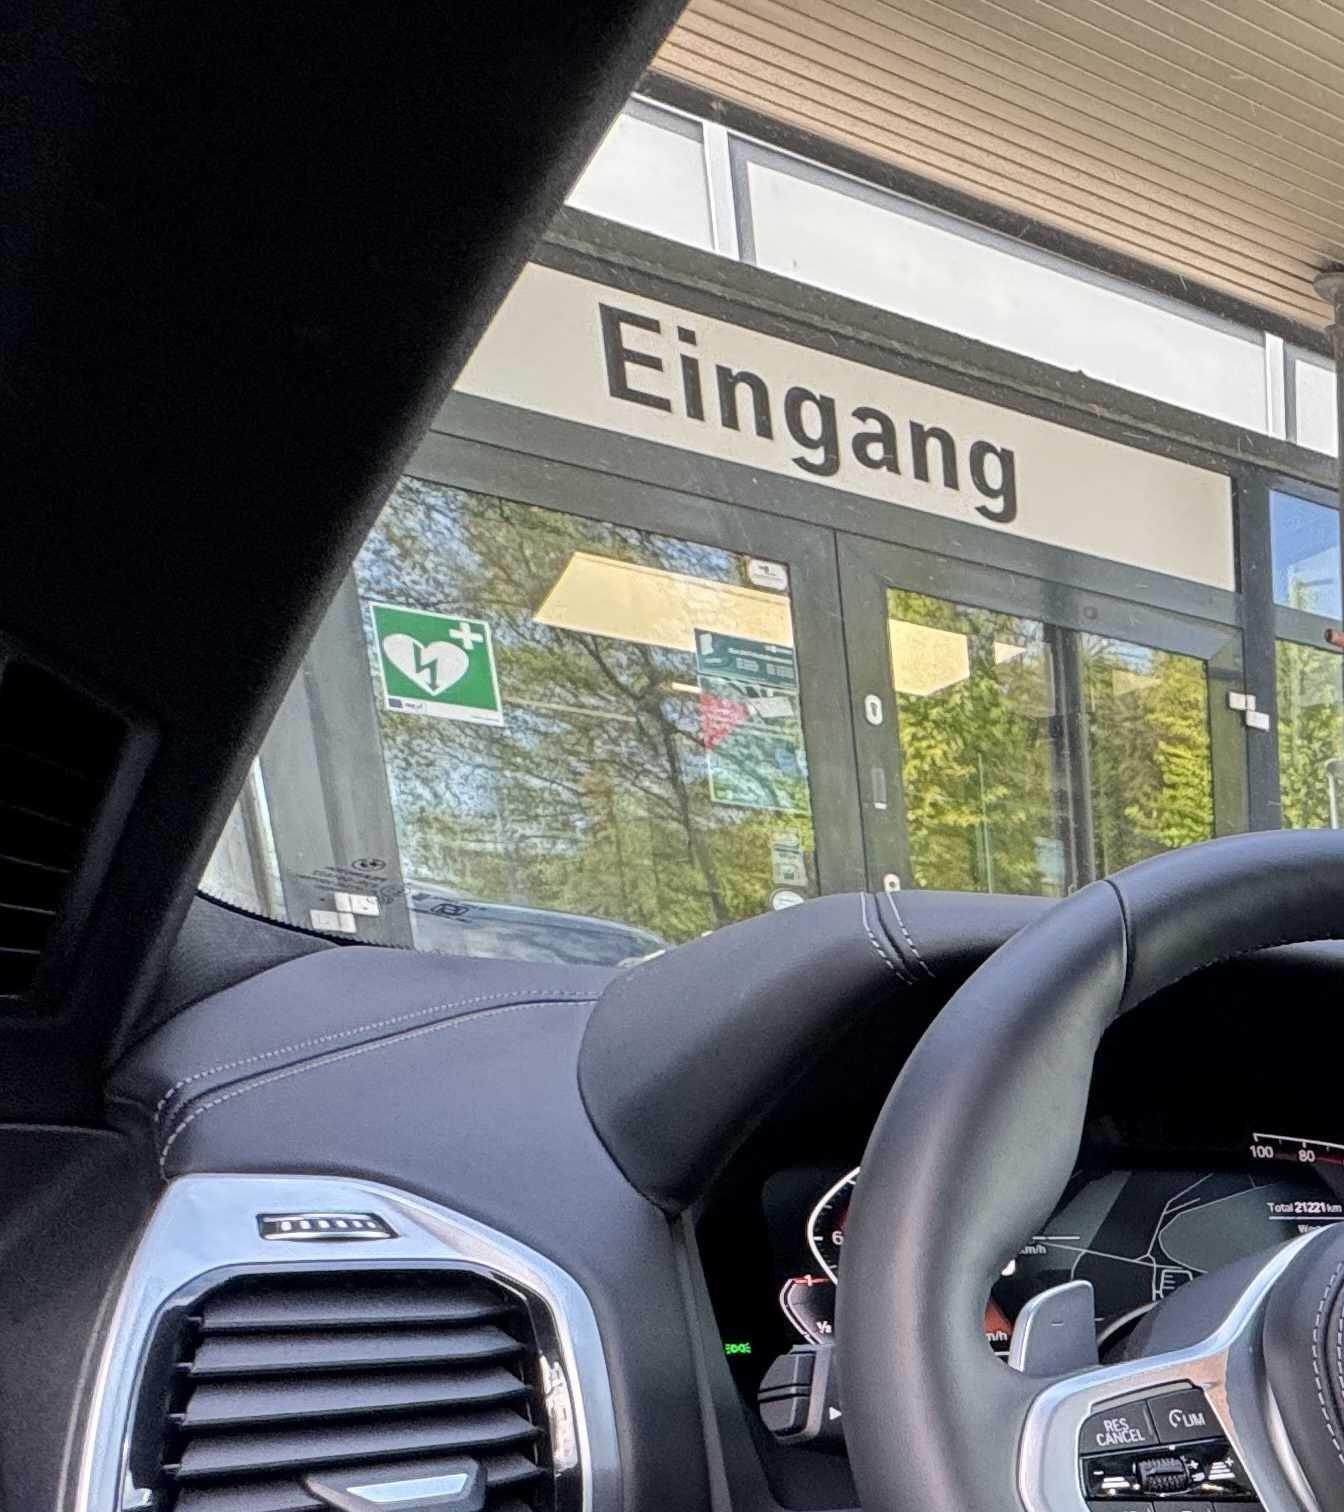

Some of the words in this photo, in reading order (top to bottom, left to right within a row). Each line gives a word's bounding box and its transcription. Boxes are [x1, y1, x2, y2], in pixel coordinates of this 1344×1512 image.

[599, 302, 1018, 524] Eingang
[1250, 1145, 1275, 1159] 100
[1298, 1150, 1316, 1163] 80
[1267, 1202, 1293, 1213] Total
[1294, 1201, 1326, 1213] 21221
[1326, 1203, 1343, 1213] km
[1103, 1418, 1129, 1433] RES
[1183, 1412, 1206, 1427] LIM
[1096, 1430, 1146, 1447] CANCEL
